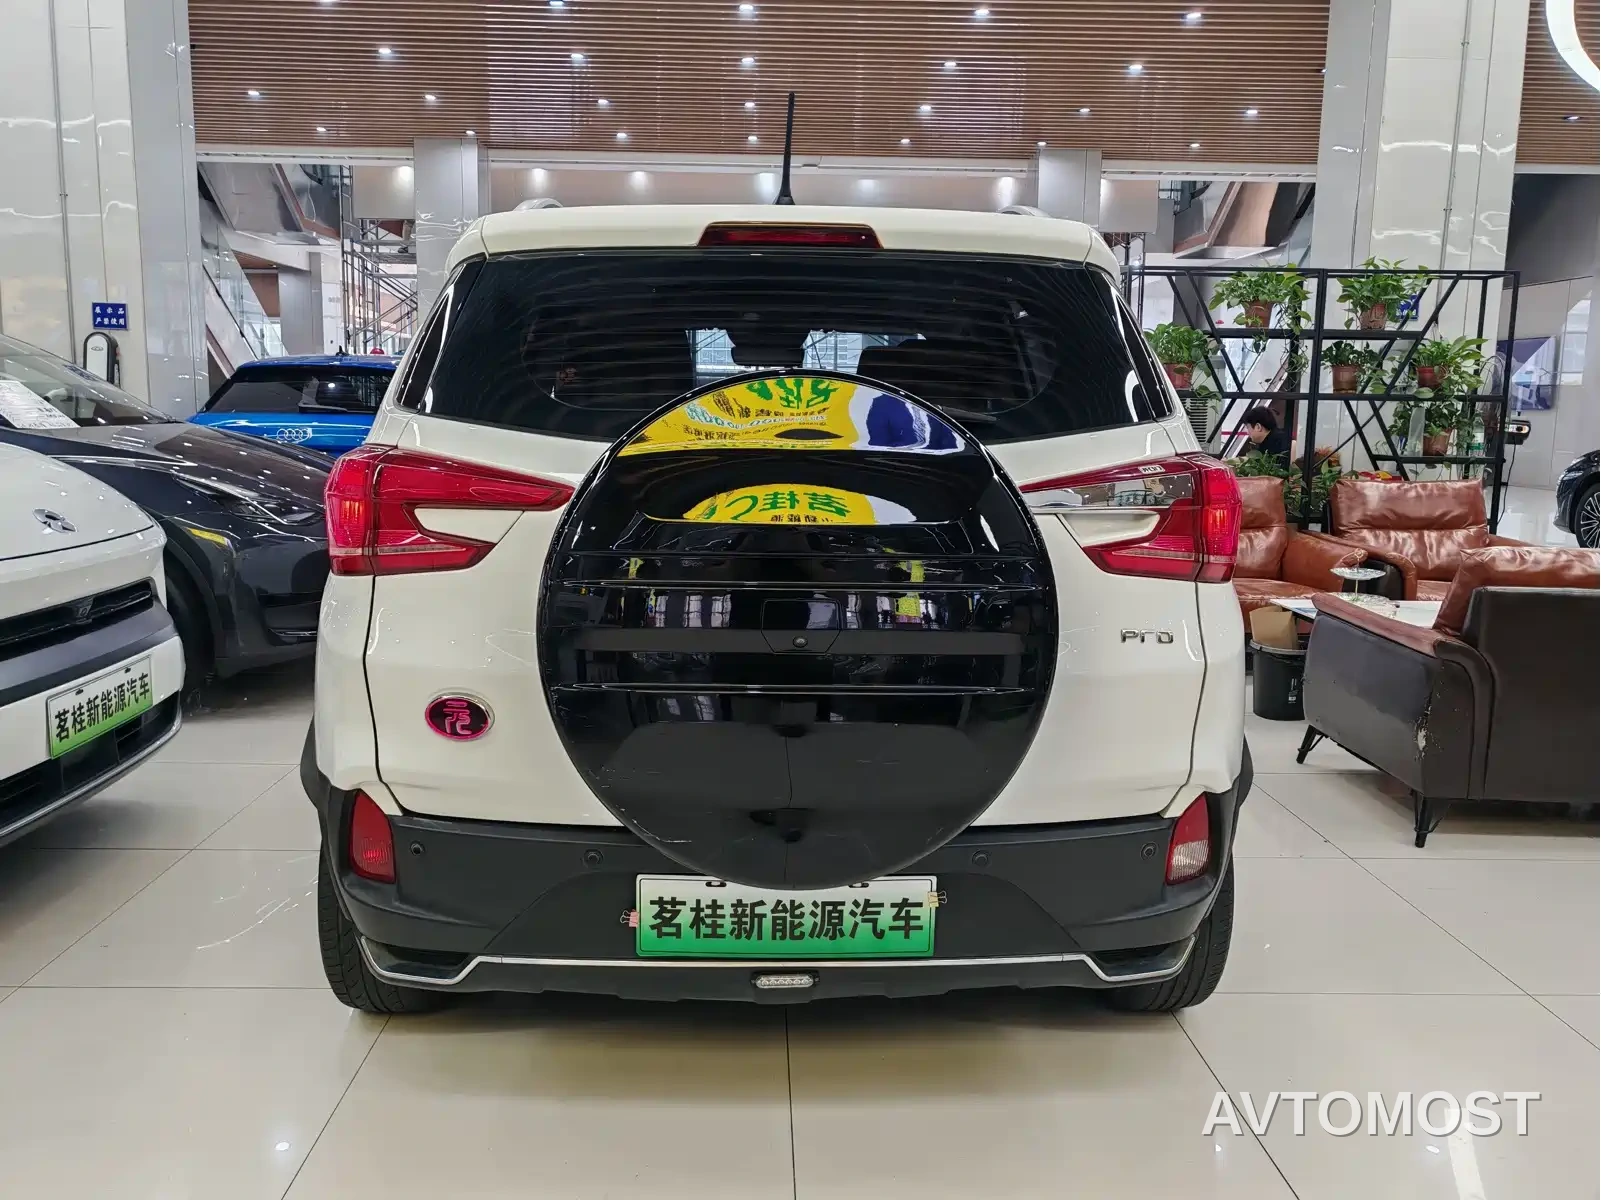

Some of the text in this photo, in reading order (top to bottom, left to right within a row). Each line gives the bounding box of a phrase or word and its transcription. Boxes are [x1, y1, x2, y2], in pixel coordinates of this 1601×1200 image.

[54, 672, 150, 743] 茗桂新能源汽车
[649, 896, 924, 941] 茗桂新能源汽车
